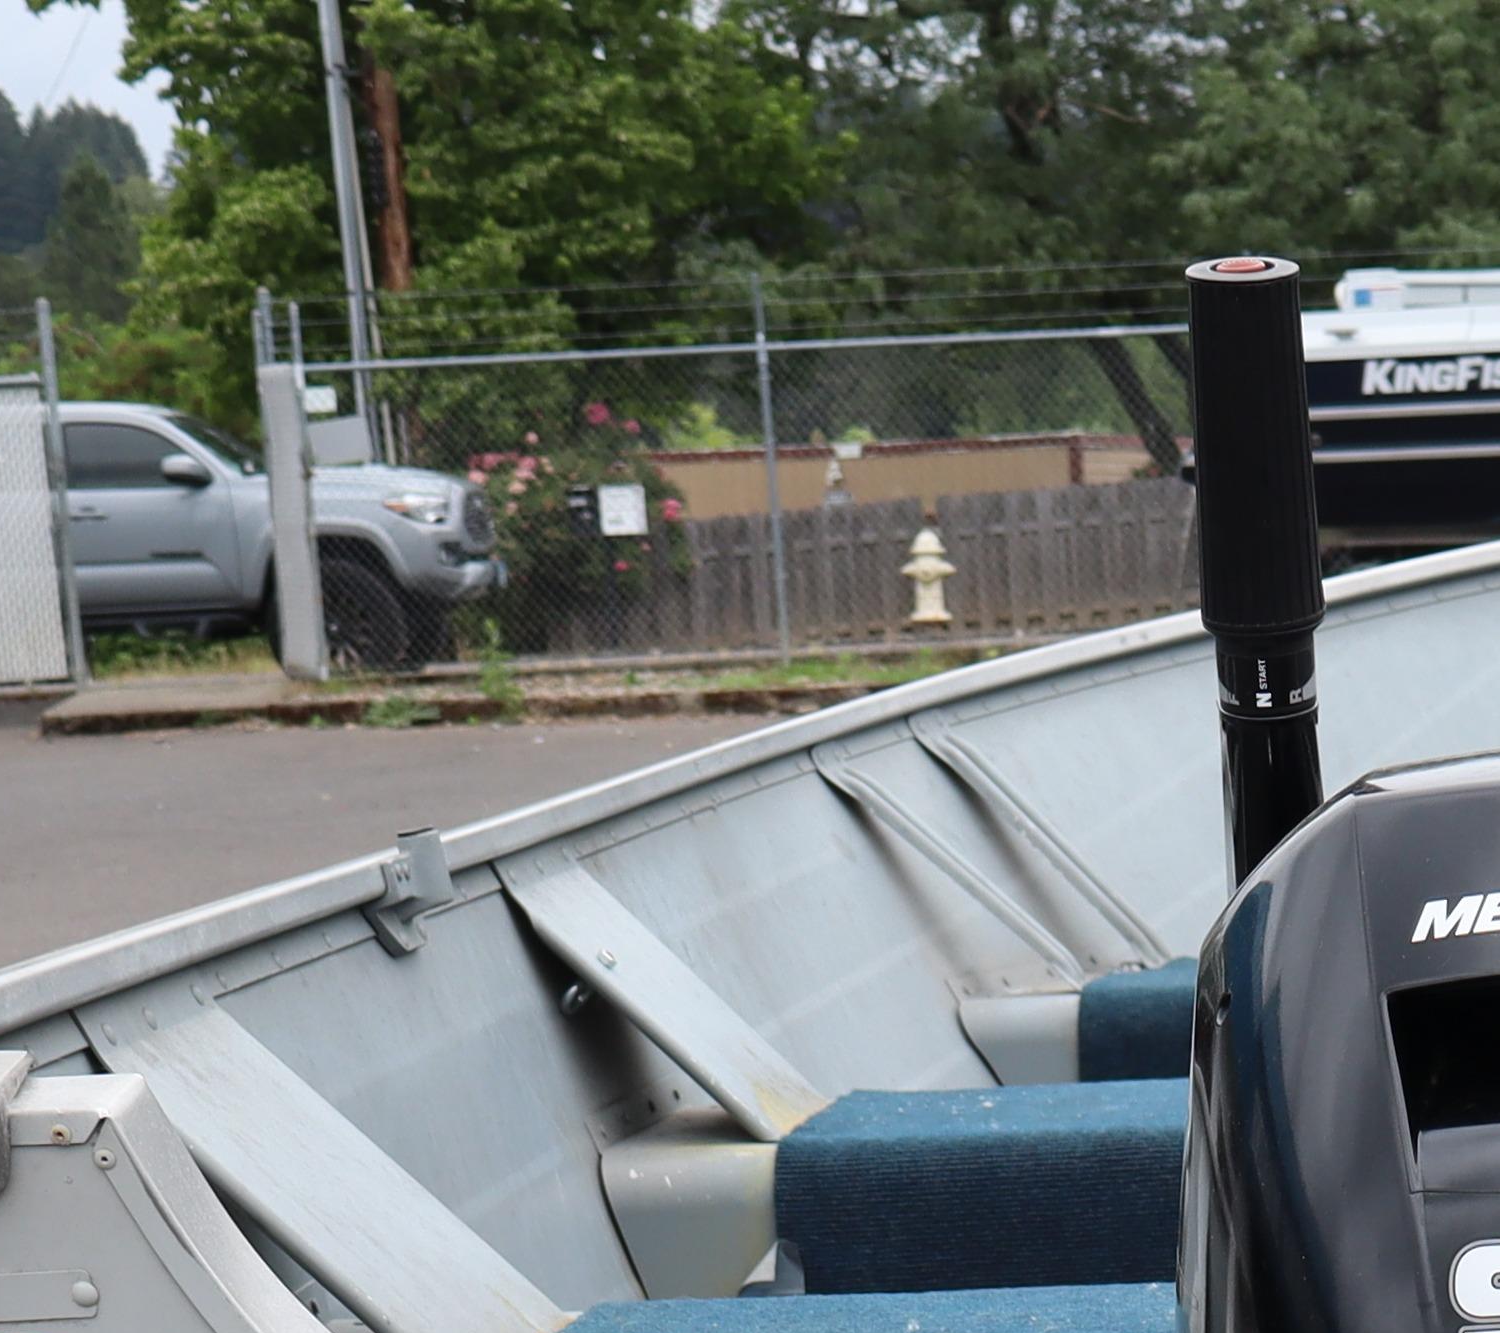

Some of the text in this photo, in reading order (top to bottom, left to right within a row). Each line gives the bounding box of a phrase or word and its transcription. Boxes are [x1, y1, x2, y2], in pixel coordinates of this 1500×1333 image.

[1257, 659, 1267, 690] START
[1255, 692, 1272, 708] N
[1289, 688, 1303, 705] R
